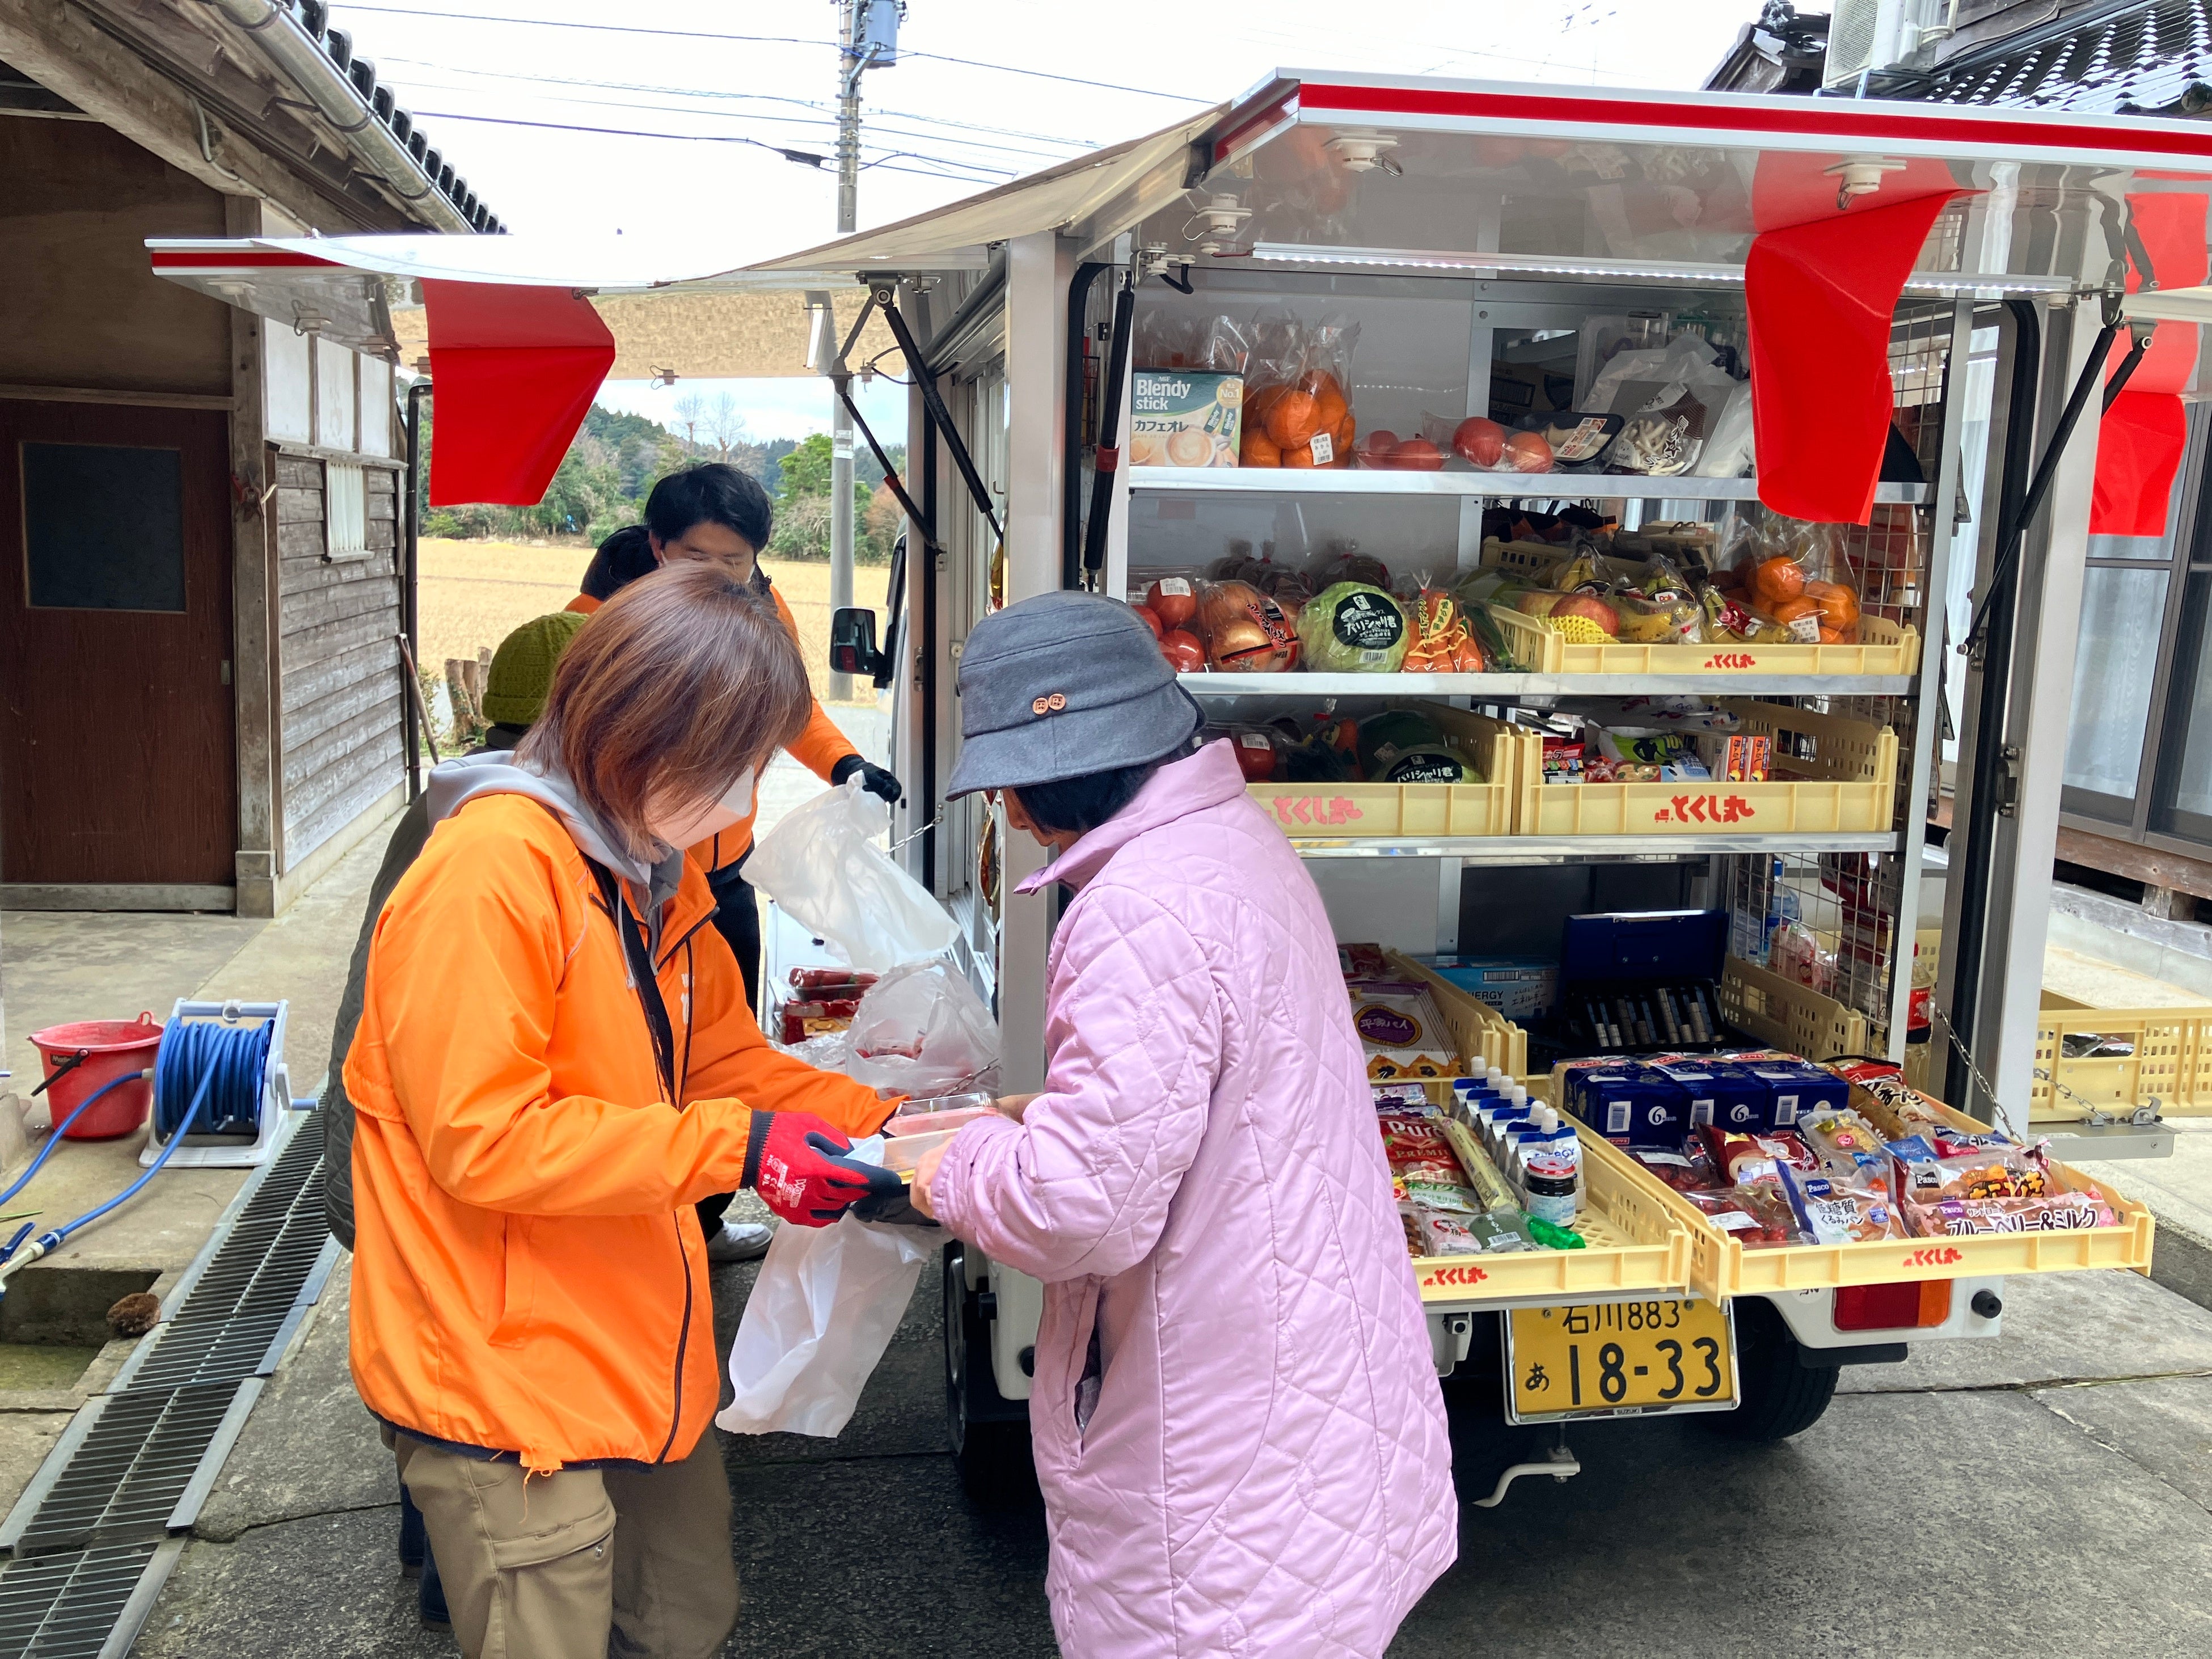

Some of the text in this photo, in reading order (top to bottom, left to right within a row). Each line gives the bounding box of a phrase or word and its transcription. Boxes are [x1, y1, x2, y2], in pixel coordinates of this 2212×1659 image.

[1136, 379, 1191, 399] Blendy
[1220, 389, 1240, 398] No.1
[1135, 397, 1169, 410] stick
[1134, 420, 1189, 433] カフェオレ
[1273, 796, 1363, 825] とくし丸
[1670, 795, 1755, 824] とくし丸
[1806, 1183, 1830, 1193] Pasco
[1940, 1206, 1963, 1214] Pasco
[1821, 1214, 1863, 1225] くるみパン
[1914, 1247, 1962, 1266] とくし丸
[1434, 1267, 1488, 1286] とくし丸
[1526, 1336, 1721, 1406] あ 18-33
